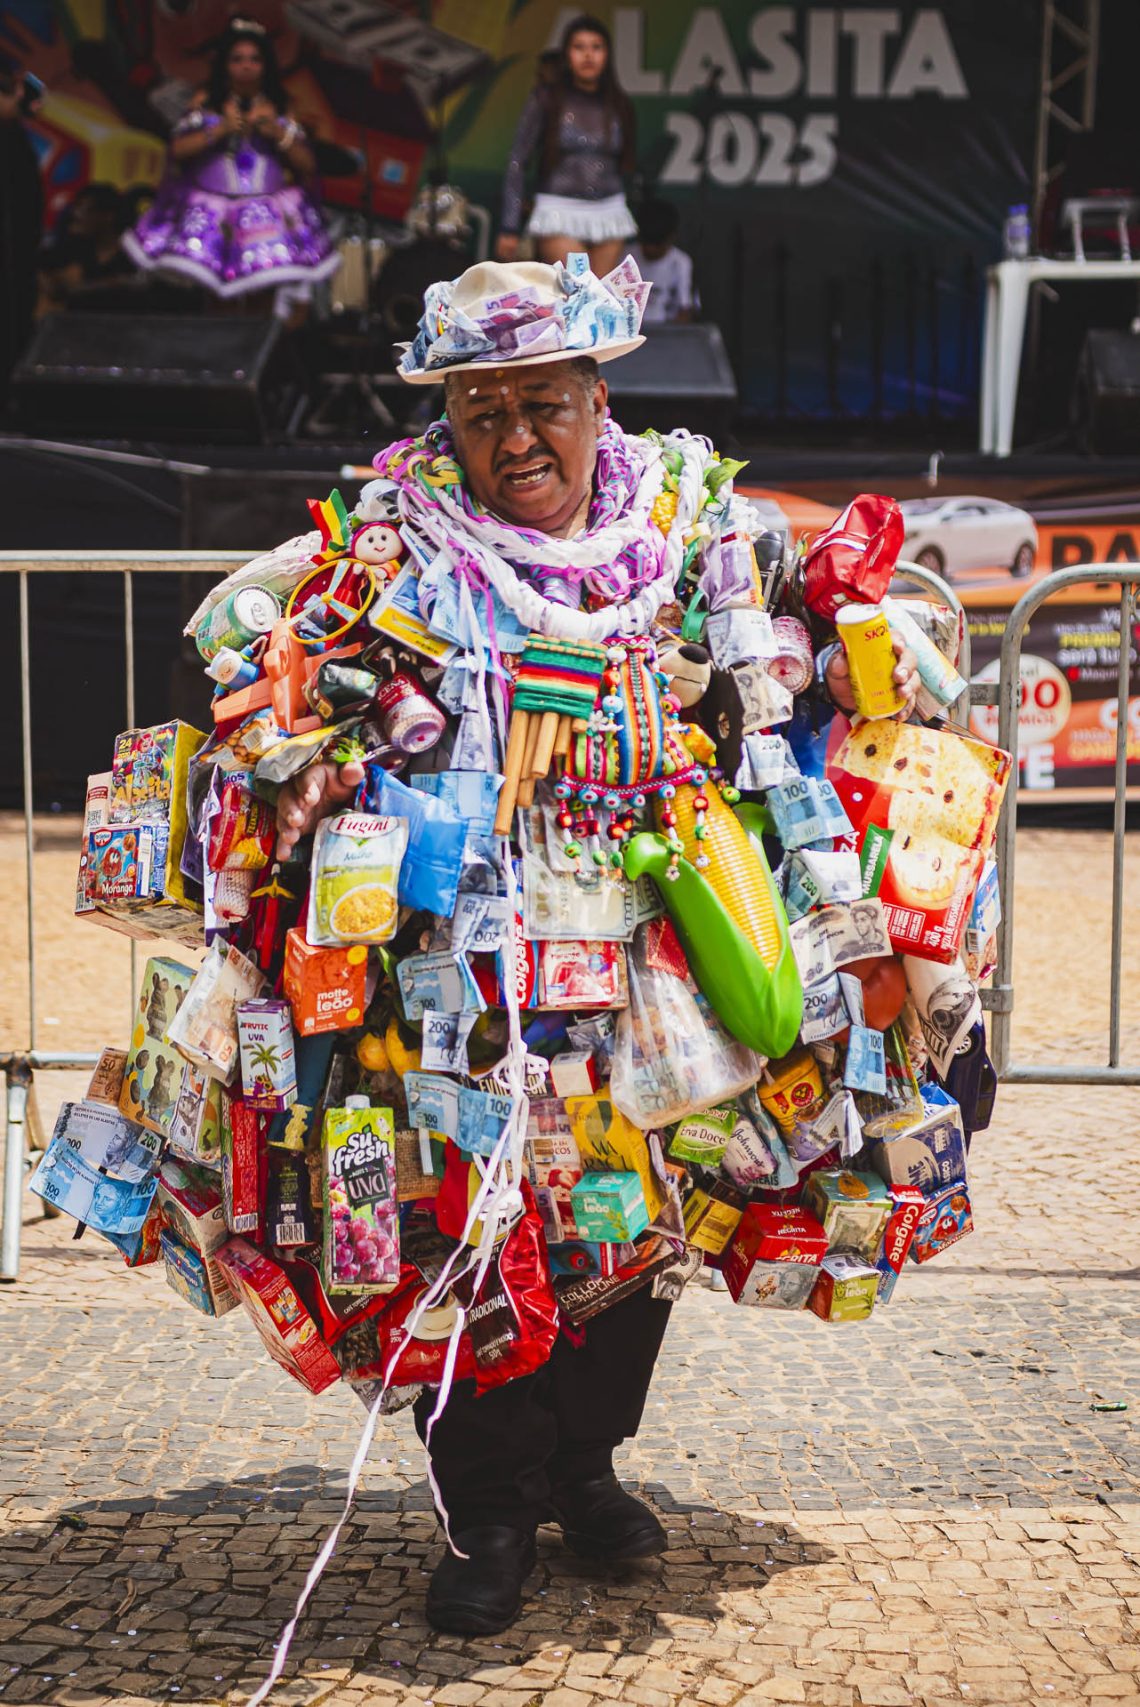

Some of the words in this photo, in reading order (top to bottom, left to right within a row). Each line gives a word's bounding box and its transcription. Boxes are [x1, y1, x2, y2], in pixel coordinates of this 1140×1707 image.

[661, 112, 838, 185] 2025
[1059, 632, 1121, 647] PREMI
[119, 739, 132, 748] 24
[783, 781, 808, 800] 100
[337, 815, 390, 834] Fugini
[863, 834, 884, 894] MUSSARELA
[101, 883, 133, 895] Morango
[515, 923, 530, 1004] Colgate
[317, 988, 349, 1000] matte
[804, 993, 828, 1010] 200
[316, 997, 352, 1013] leão
[428, 1020, 450, 1033] 200
[248, 1033, 265, 1042] UVA
[870, 1034, 882, 1050] 100
[101, 1058, 115, 1070] 50
[490, 1098, 512, 1116] 100
[424, 1113, 437, 1123] 100
[140, 1132, 156, 1150] 200
[680, 1126, 698, 1137] Erva
[700, 1128, 726, 1146] Doce
[334, 1141, 389, 1177] fresh
[46, 1181, 59, 1197] 100
[136, 1181, 155, 1195] 100
[777, 1226, 806, 1236] NEGRITA
[890, 1205, 919, 1263] Colgate
